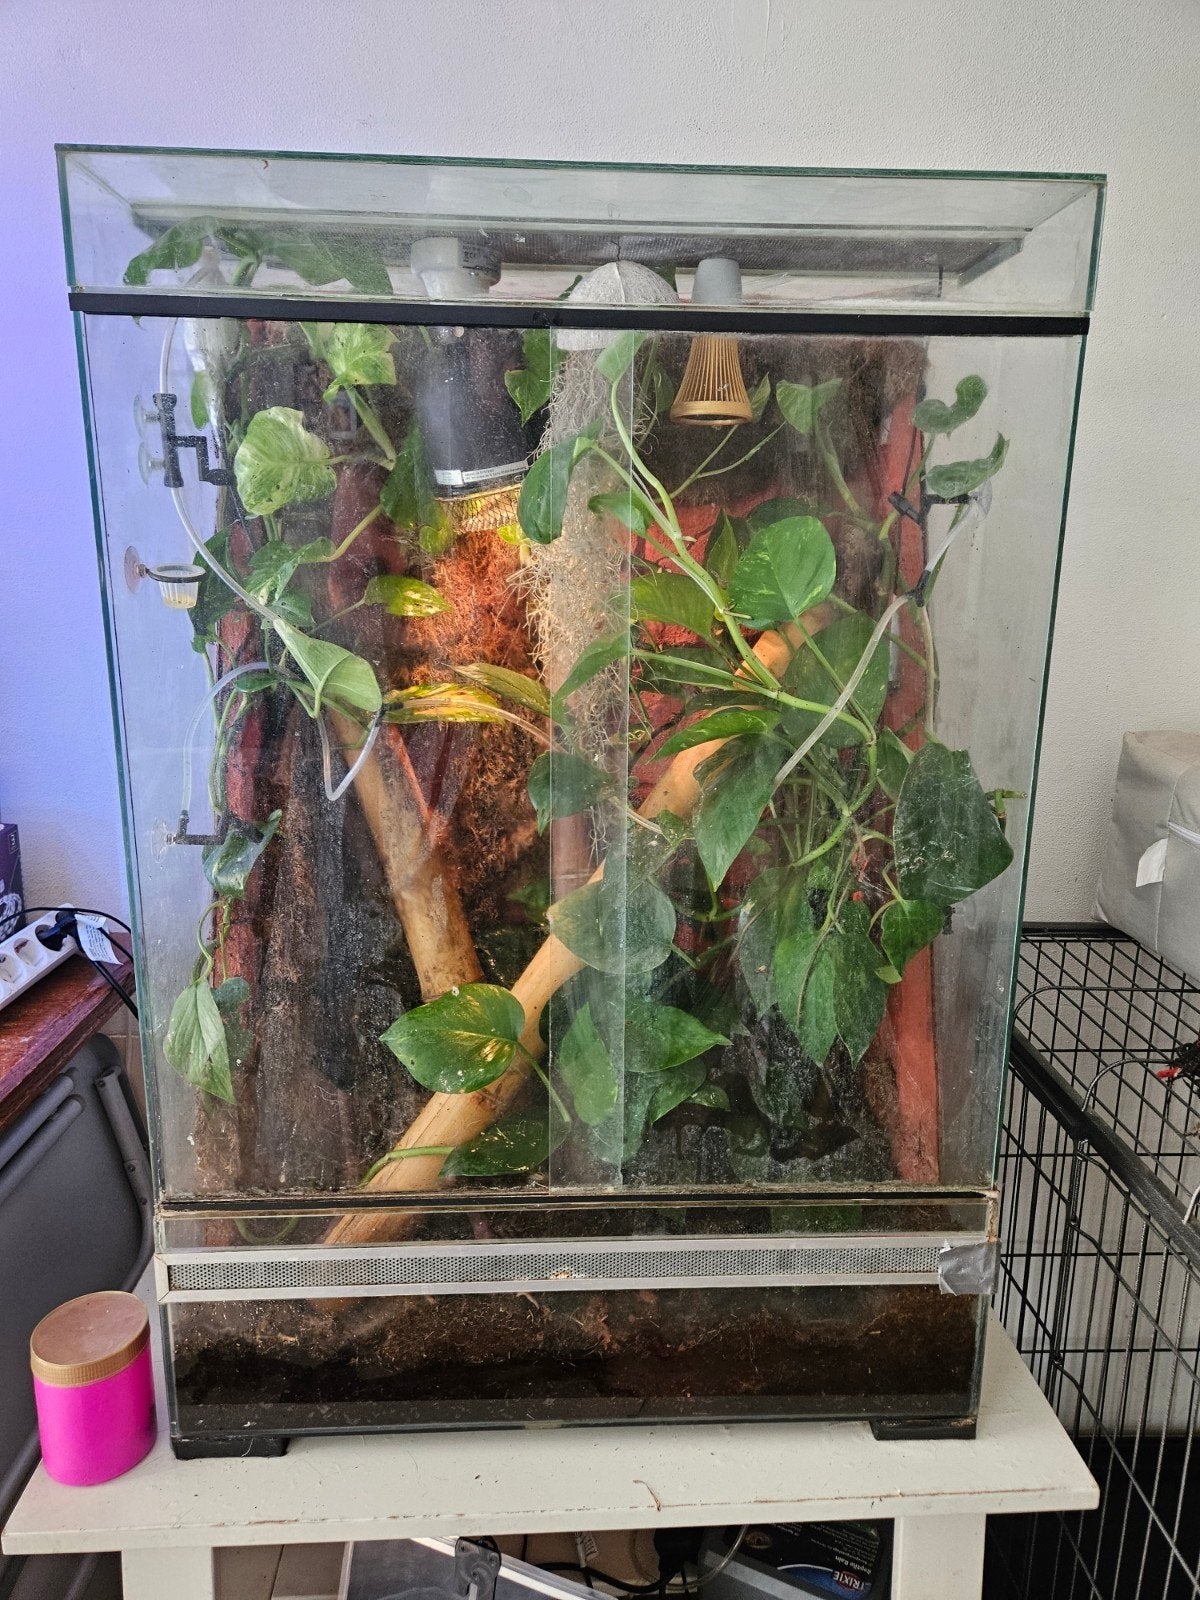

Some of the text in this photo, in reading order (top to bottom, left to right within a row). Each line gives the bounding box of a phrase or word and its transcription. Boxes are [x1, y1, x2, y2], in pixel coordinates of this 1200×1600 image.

[834, 1555, 872, 1575] Reptile Rain
[833, 1570, 865, 1590] TRIXIE
